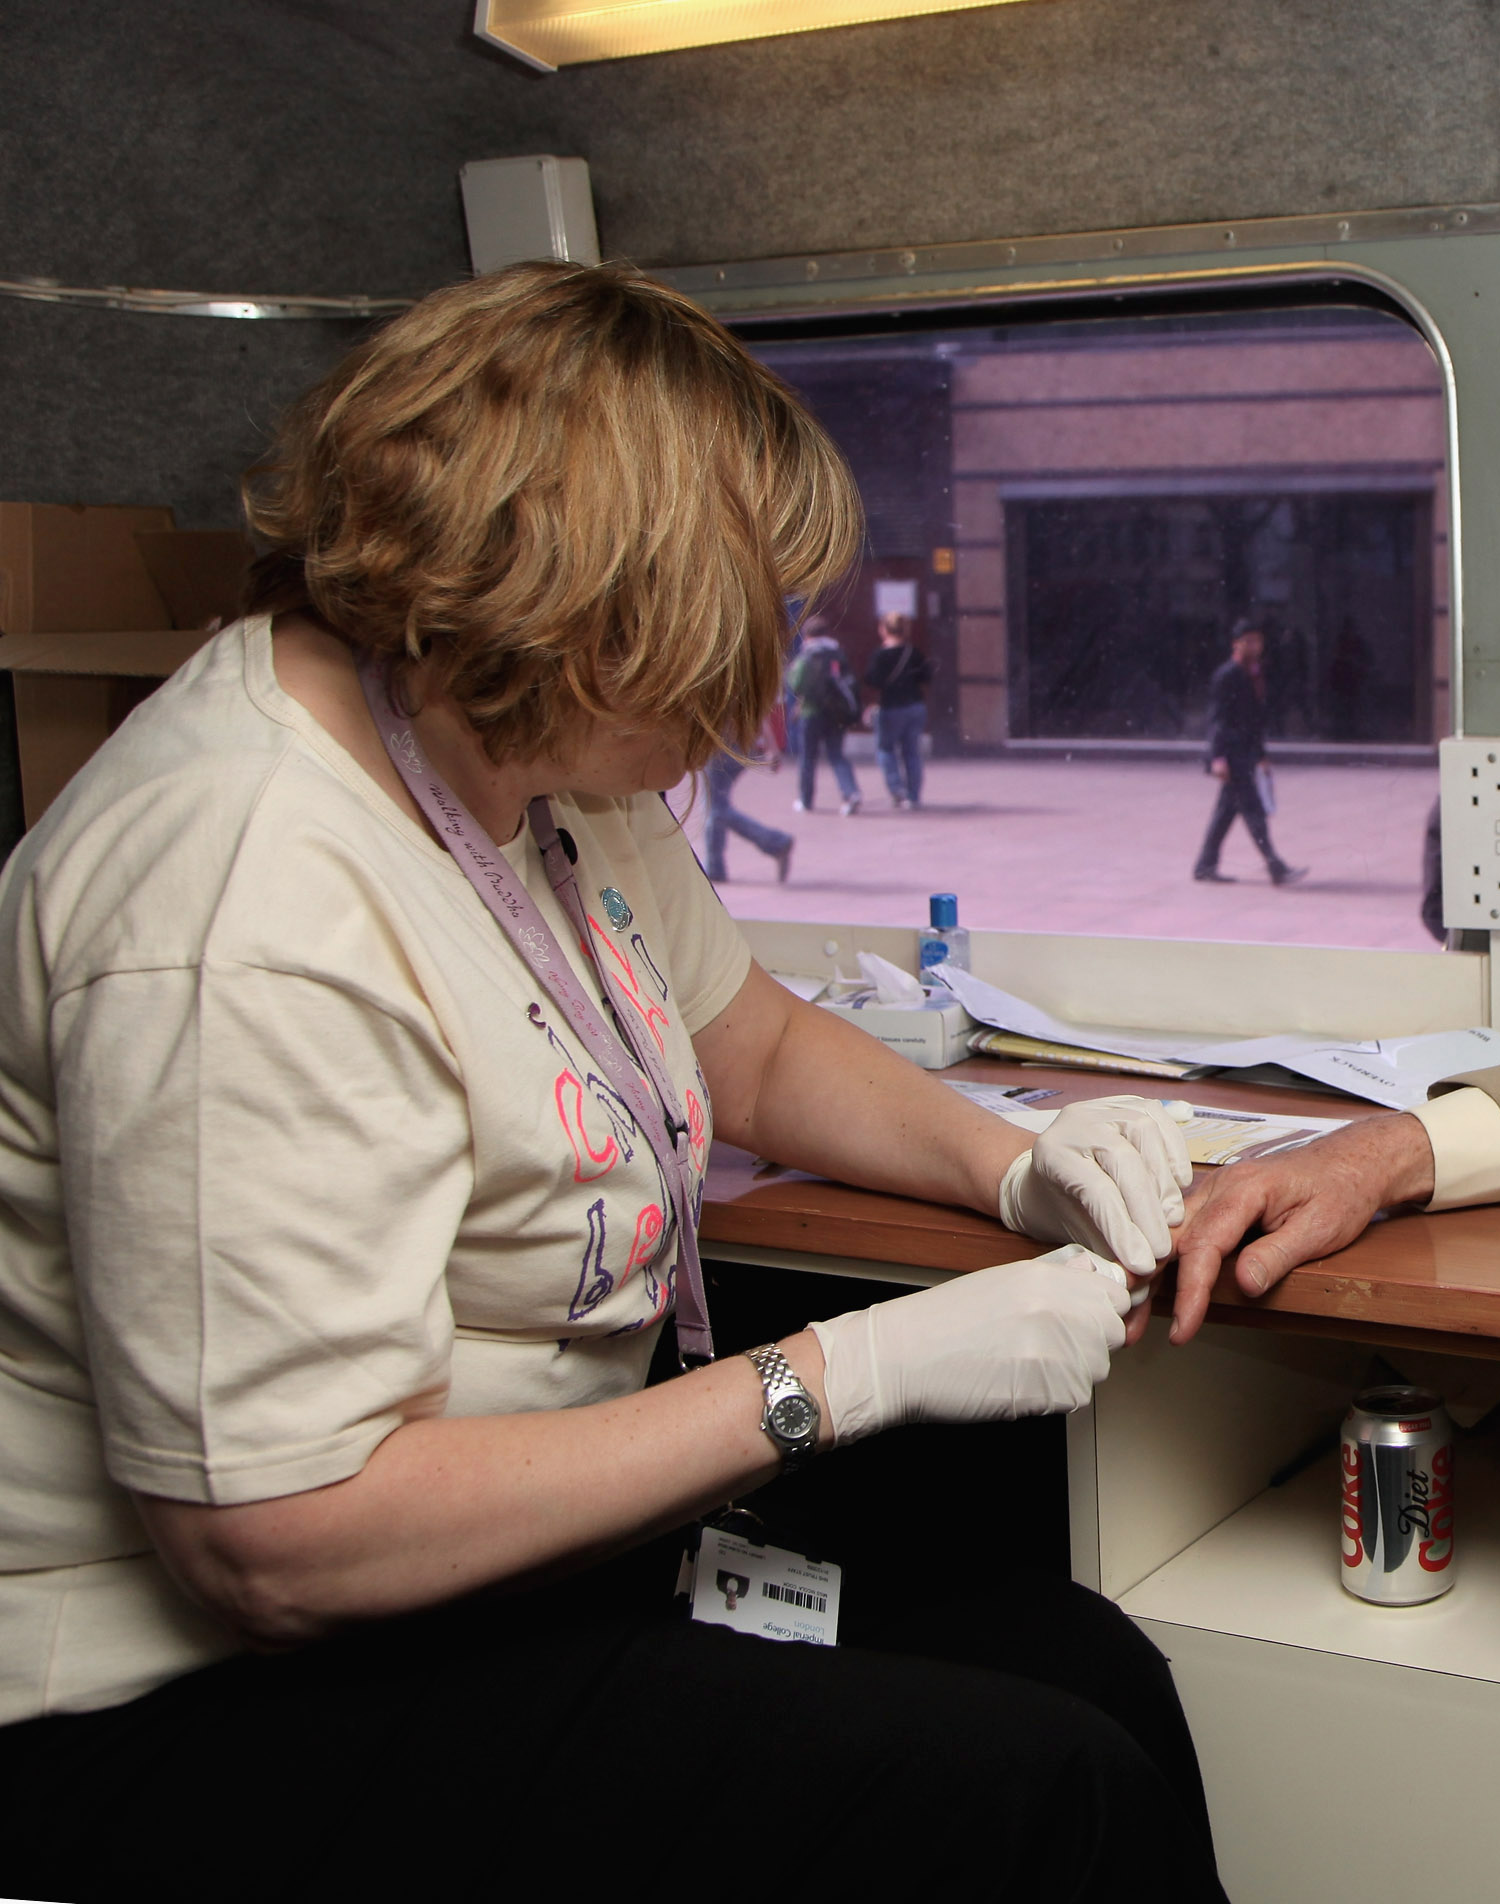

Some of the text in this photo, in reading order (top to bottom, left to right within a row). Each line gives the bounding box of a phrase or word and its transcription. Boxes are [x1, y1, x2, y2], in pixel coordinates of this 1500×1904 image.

[429, 783, 524, 918] Walking with Buddha
[1397, 1468, 1429, 1538] Diet
[1418, 1445, 1454, 1572] Coke
[762, 1620, 790, 1637] College
[794, 1620, 823, 1634] London
